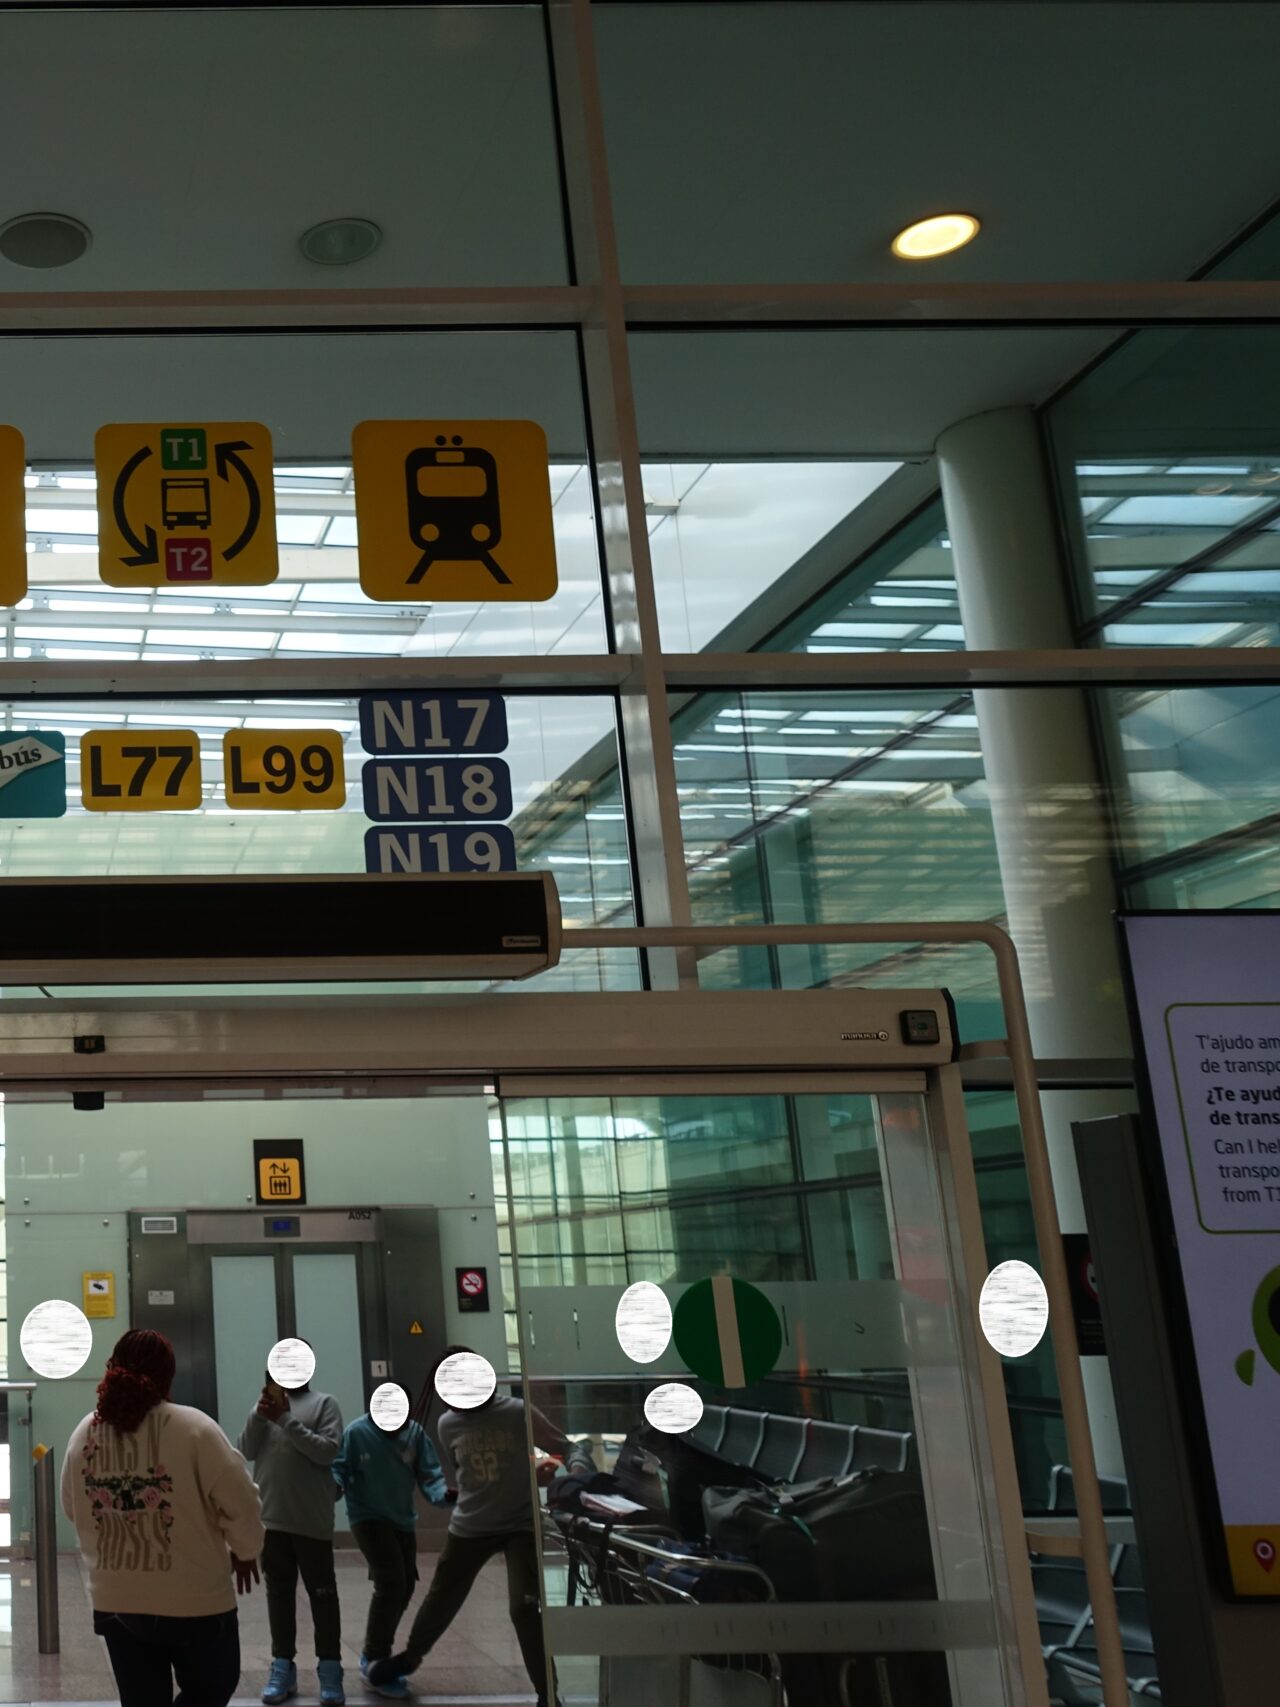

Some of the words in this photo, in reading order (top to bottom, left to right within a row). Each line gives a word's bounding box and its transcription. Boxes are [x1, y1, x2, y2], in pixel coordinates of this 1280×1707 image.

[165, 437, 203, 462] T1
[169, 546, 208, 573] T2
[372, 699, 491, 748] N17
[89, 745, 194, 798] L77
[230, 744, 335, 795] L99
[376, 764, 498, 815] N18
[378, 831, 502, 872] N19
[1195, 1034, 1254, 1052] T'ajudo
[1201, 1058, 1220, 1073] de
[1206, 1086, 1235, 1104] ¿Te
[1210, 1110, 1231, 1125] de
[1235, 1110, 1280, 1125] trans
[1214, 1138, 1245, 1154] Can
[1248, 1138, 1254, 1154] I
[1222, 1186, 1262, 1202] from
[470, 1453, 498, 1481] 92
